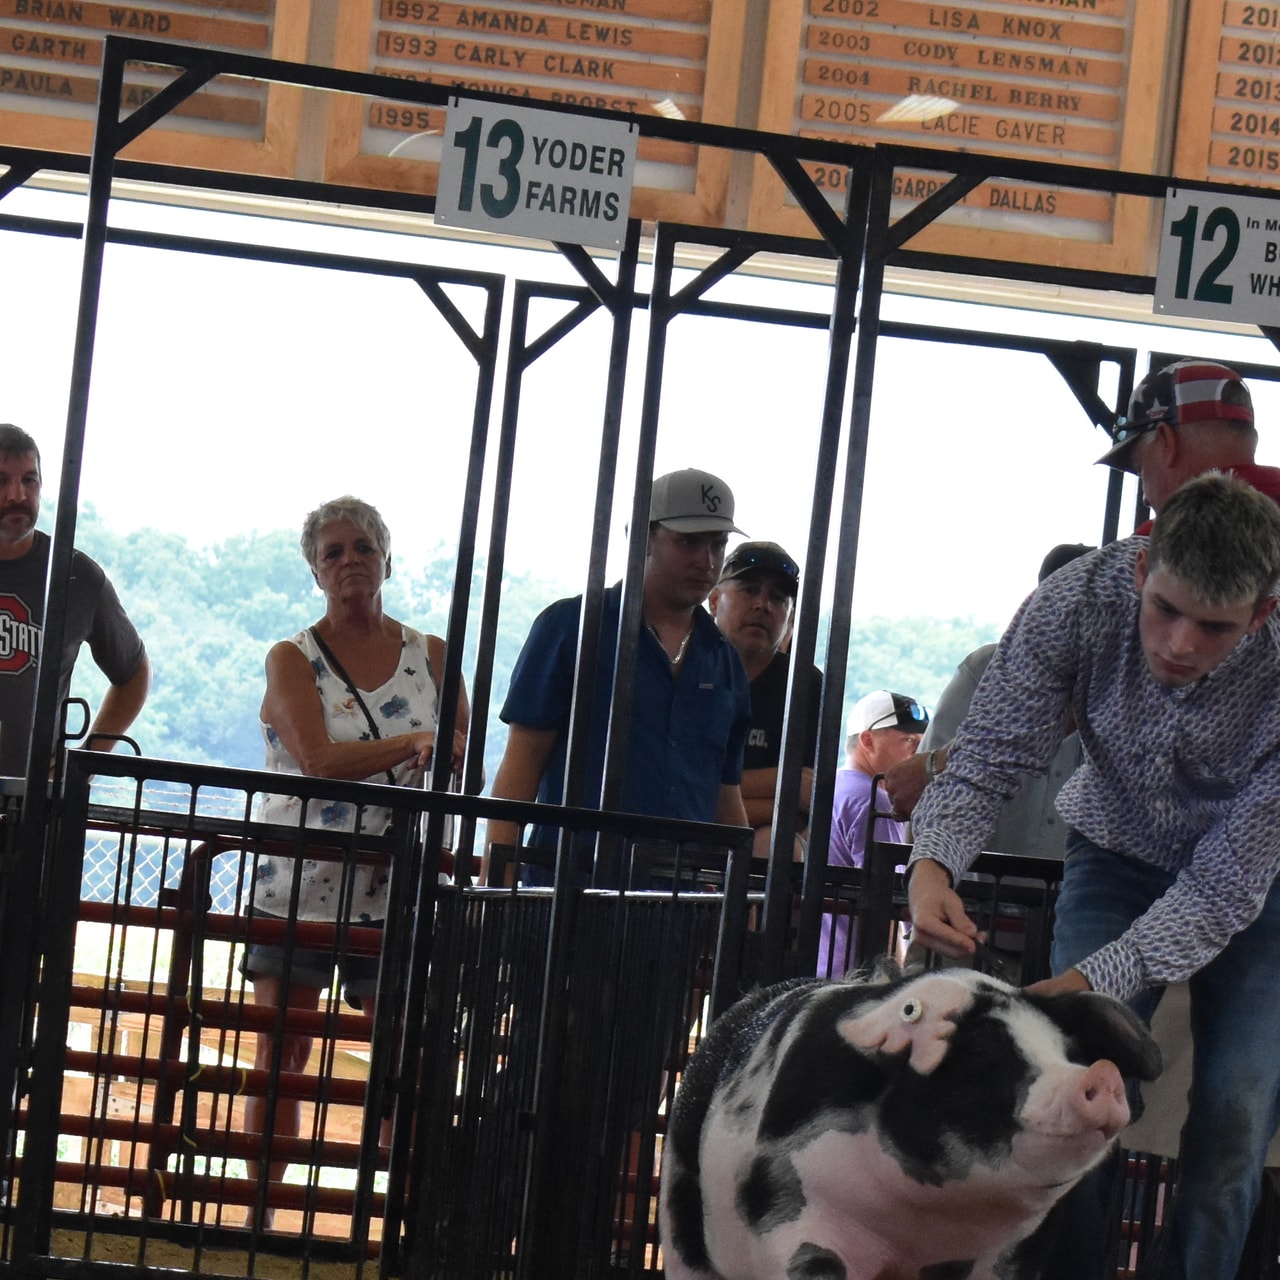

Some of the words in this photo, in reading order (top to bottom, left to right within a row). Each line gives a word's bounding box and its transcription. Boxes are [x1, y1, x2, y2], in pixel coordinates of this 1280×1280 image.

[15, 0, 83, 22] BRIAN
[109, 7, 171, 33] WARD
[387, 0, 440, 22] 1992
[456, 11, 549, 37] AMANDA
[566, 21, 633, 47] LEWIS
[822, 0, 880, 18] 2002
[929, 8, 982, 32] LISA
[1001, 17, 1063, 42] KNOX
[11, 33, 87, 60] GARTH
[383, 33, 437, 57] 1993
[454, 43, 527, 70] CARLY
[544, 54, 615, 81] CLARK
[818, 30, 872, 52] 2003
[903, 39, 960, 63] CODY
[977, 49, 1089, 78] LENSMAN
[0, 69, 73, 97] PAULA
[818, 65, 872, 87] 2004
[907, 76, 997, 103] RACHEL
[1008, 87, 1083, 113] BERRY
[375, 106, 431, 129] 1995
[813, 98, 872, 125] 2005
[920, 109, 981, 137] LACIE
[995, 118, 1066, 146] GAVER
[453, 115, 525, 220] 13
[532, 135, 626, 178] YODER
[1228, 146, 1280, 172] 2015
[524, 180, 620, 222] FARMS
[988, 187, 1057, 215] DALLAS
[1169, 203, 1241, 305] 12
[1245, 215, 1261, 230] In
